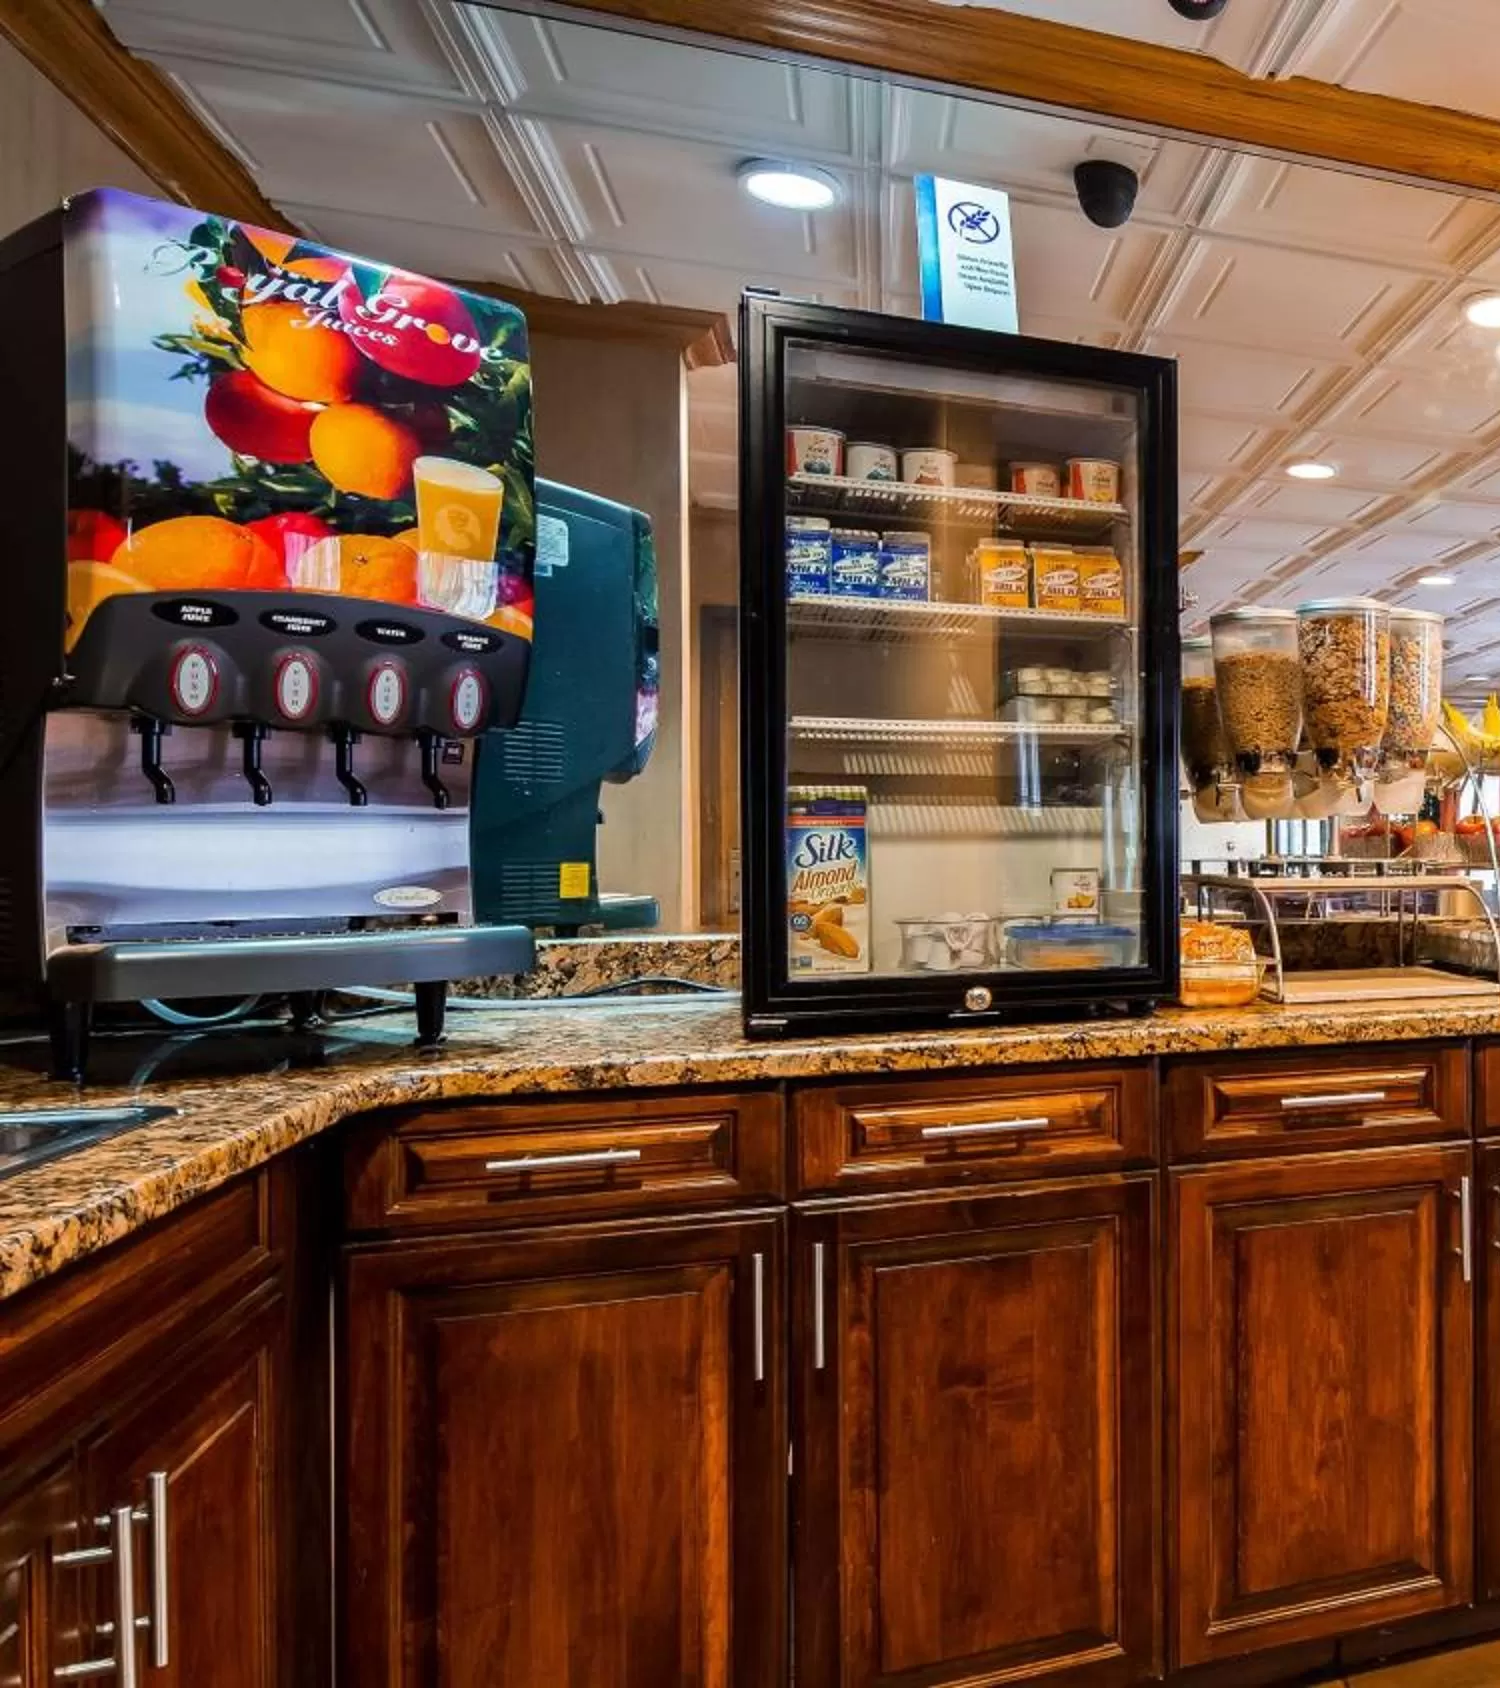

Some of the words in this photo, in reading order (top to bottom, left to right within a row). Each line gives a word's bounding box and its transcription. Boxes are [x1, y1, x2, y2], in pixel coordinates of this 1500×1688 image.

[290, 306, 399, 348] Juices
[356, 291, 504, 361] Grove
[180, 604, 212, 616] APPLE
[794, 832, 857, 869] Silk
[792, 859, 857, 893] Almond
